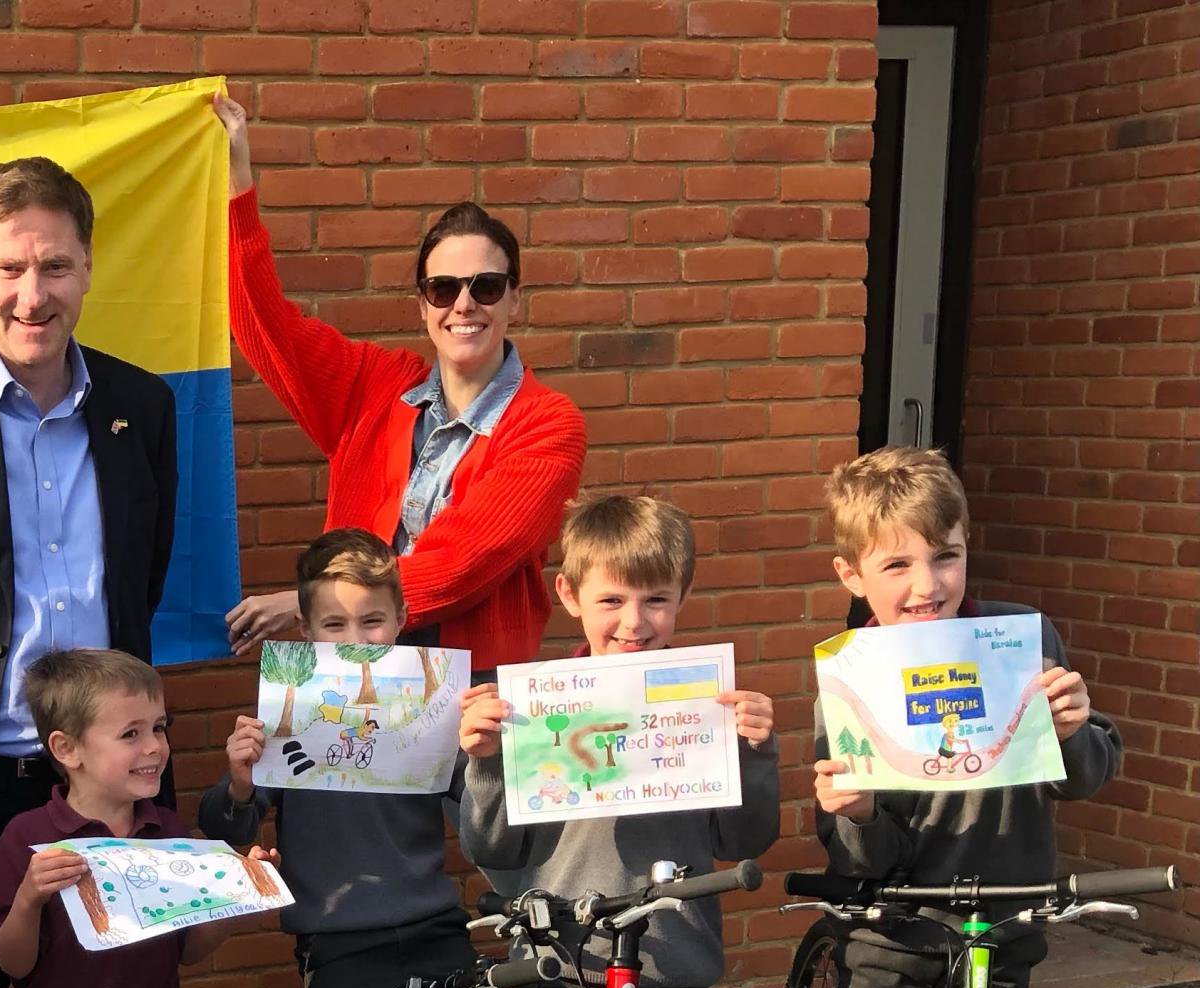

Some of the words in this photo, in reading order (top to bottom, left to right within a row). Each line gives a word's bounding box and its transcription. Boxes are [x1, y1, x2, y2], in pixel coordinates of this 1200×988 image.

[528, 676, 566, 694] Ride
[572, 673, 597, 690] for
[912, 672, 945, 687] Raise
[948, 667, 977, 684] Money
[530, 699, 594, 718] Ukraine
[911, 700, 932, 715] for
[935, 697, 979, 714] Ukraine
[640, 713, 658, 730] 32
[660, 711, 702, 727] miles
[616, 734, 649, 753] Red
[654, 728, 714, 750] Squirrel
[651, 752, 685, 769] Trail
[595, 785, 636, 803] Noah
